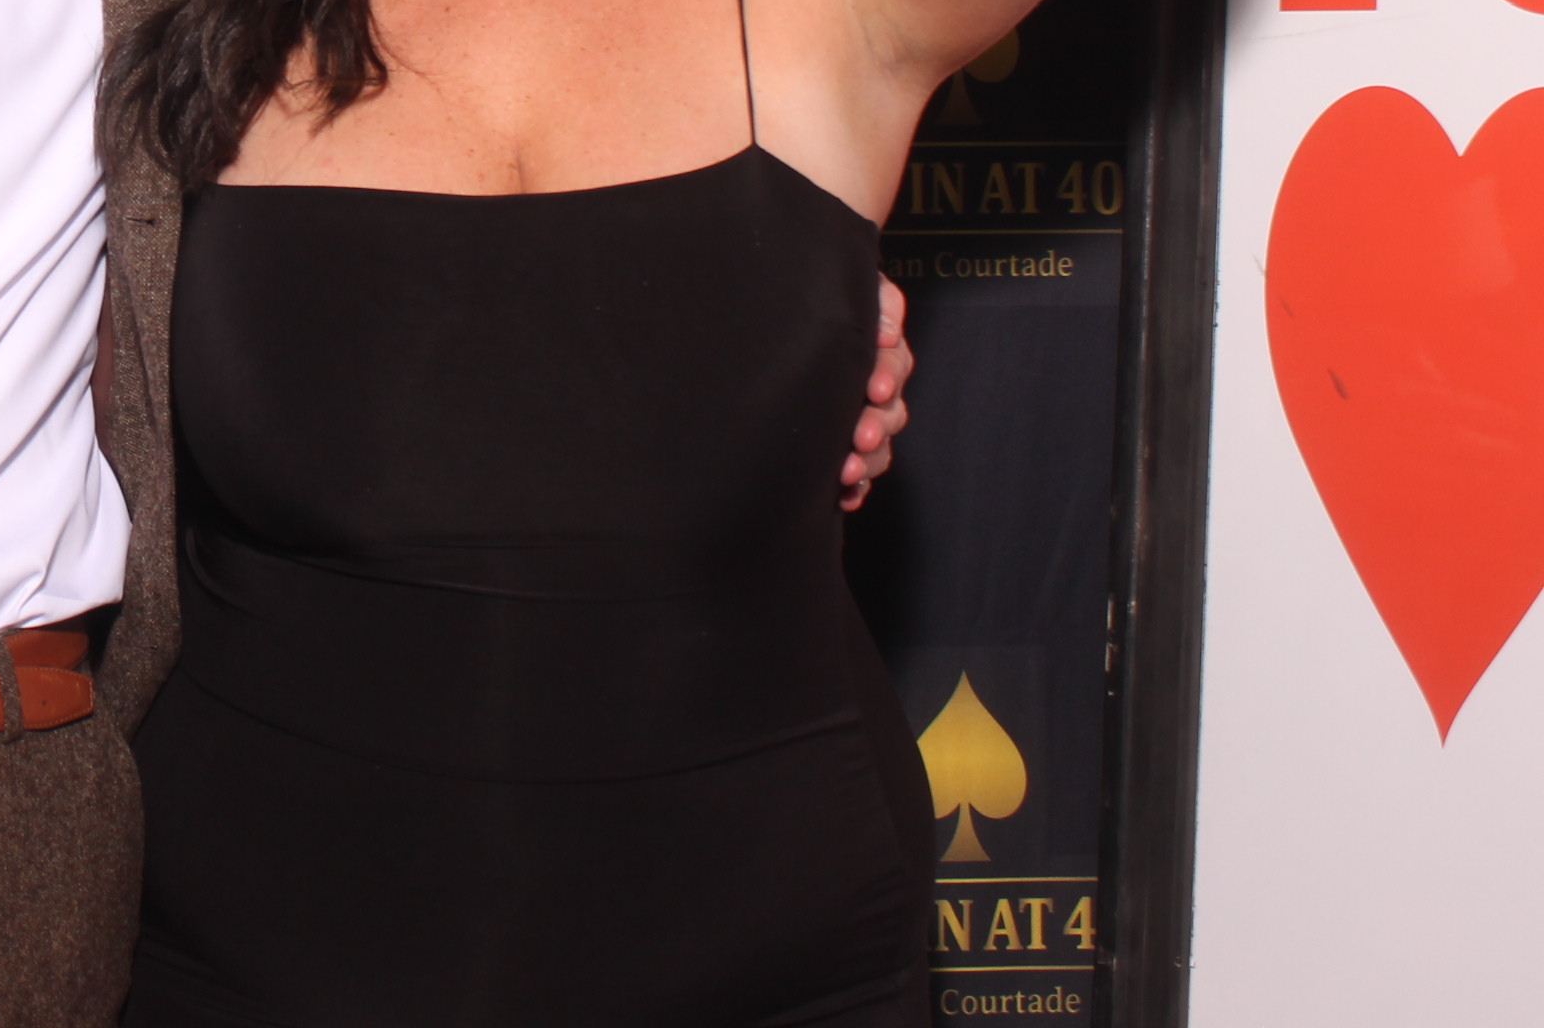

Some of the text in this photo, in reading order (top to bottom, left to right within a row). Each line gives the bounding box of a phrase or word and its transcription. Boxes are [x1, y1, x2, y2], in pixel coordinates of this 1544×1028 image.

[909, 160, 1125, 216] IN AT 40
[882, 250, 1075, 278] an Courtade
[933, 896, 1097, 952] N AT 4
[940, 985, 1082, 1016] Courtade
